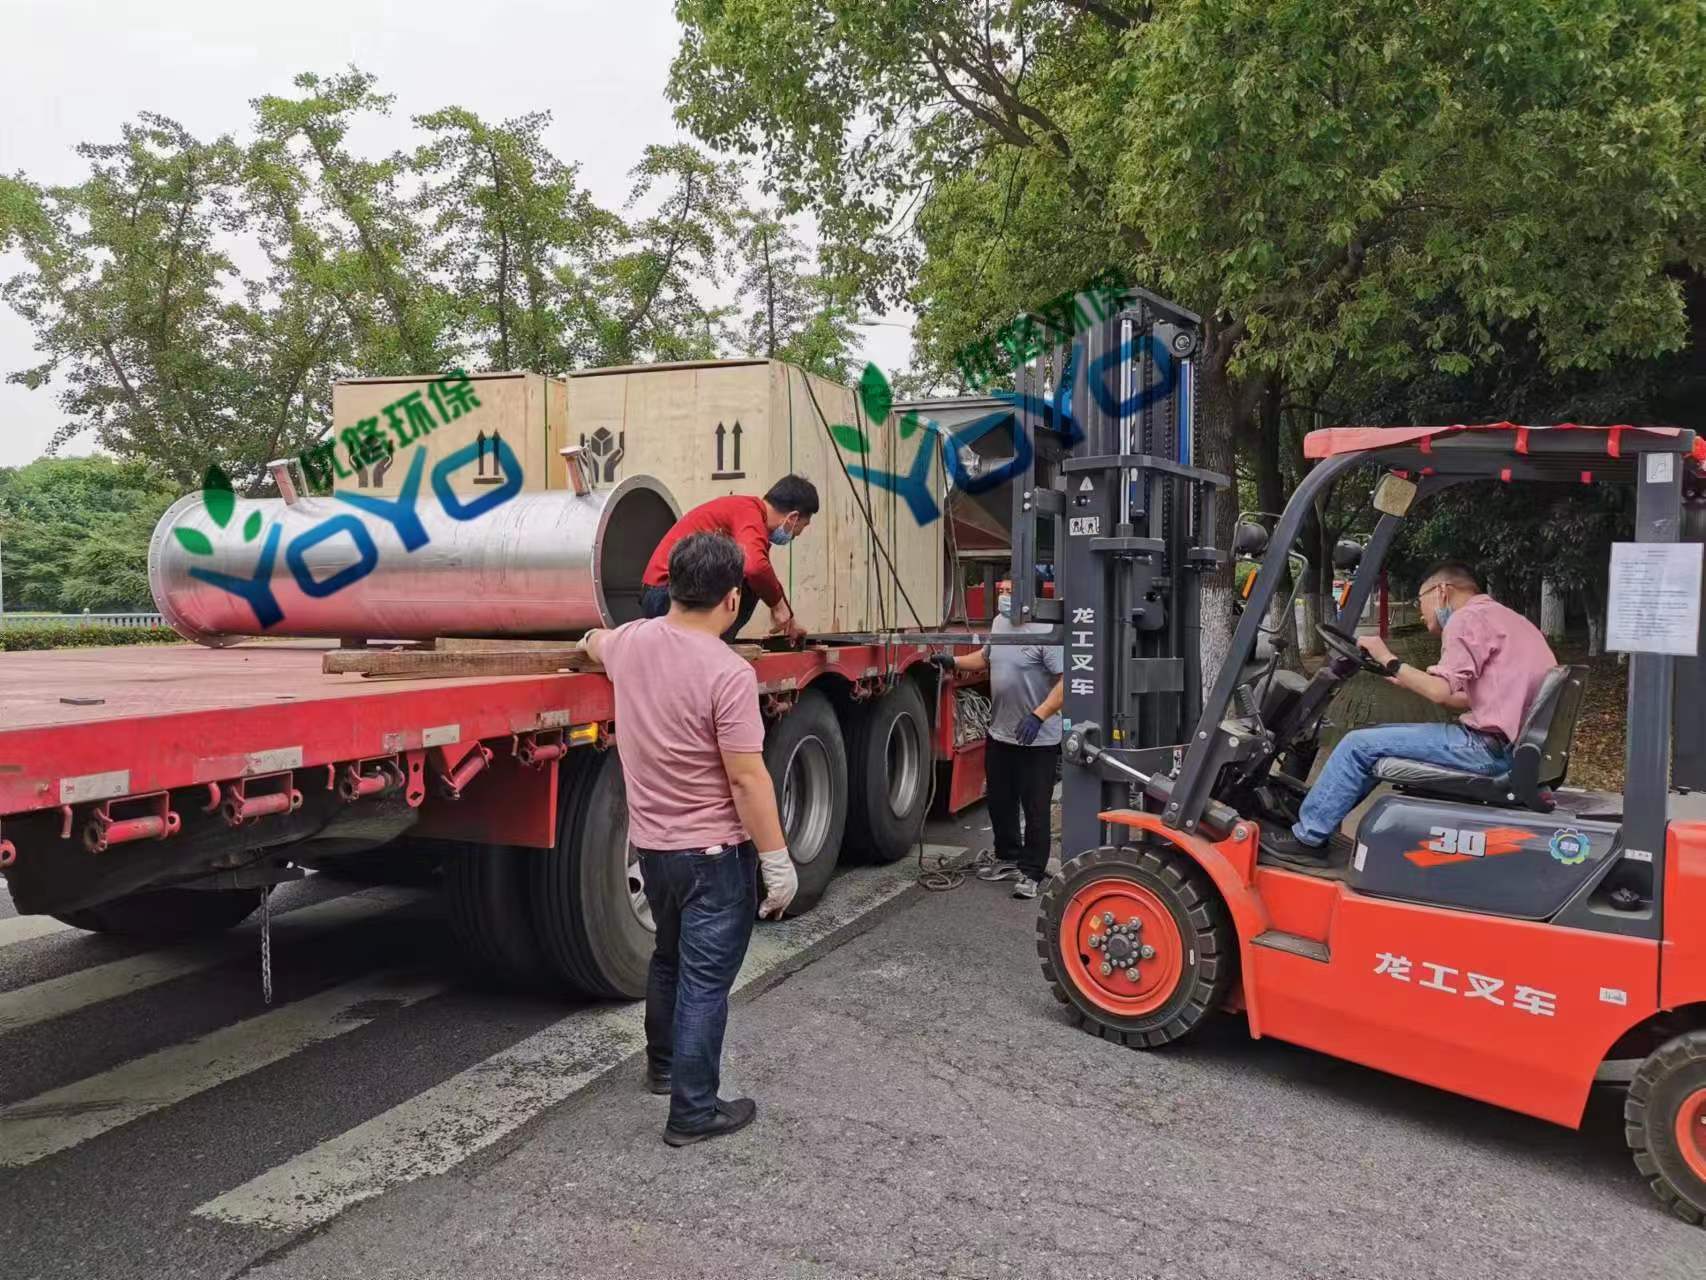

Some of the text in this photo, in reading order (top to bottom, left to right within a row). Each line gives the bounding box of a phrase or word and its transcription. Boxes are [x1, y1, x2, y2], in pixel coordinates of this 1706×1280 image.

[1071, 608, 1095, 695] 龙工叉车
[1428, 826, 1487, 857] 30
[1373, 952, 1556, 1017] 龙工叉车
